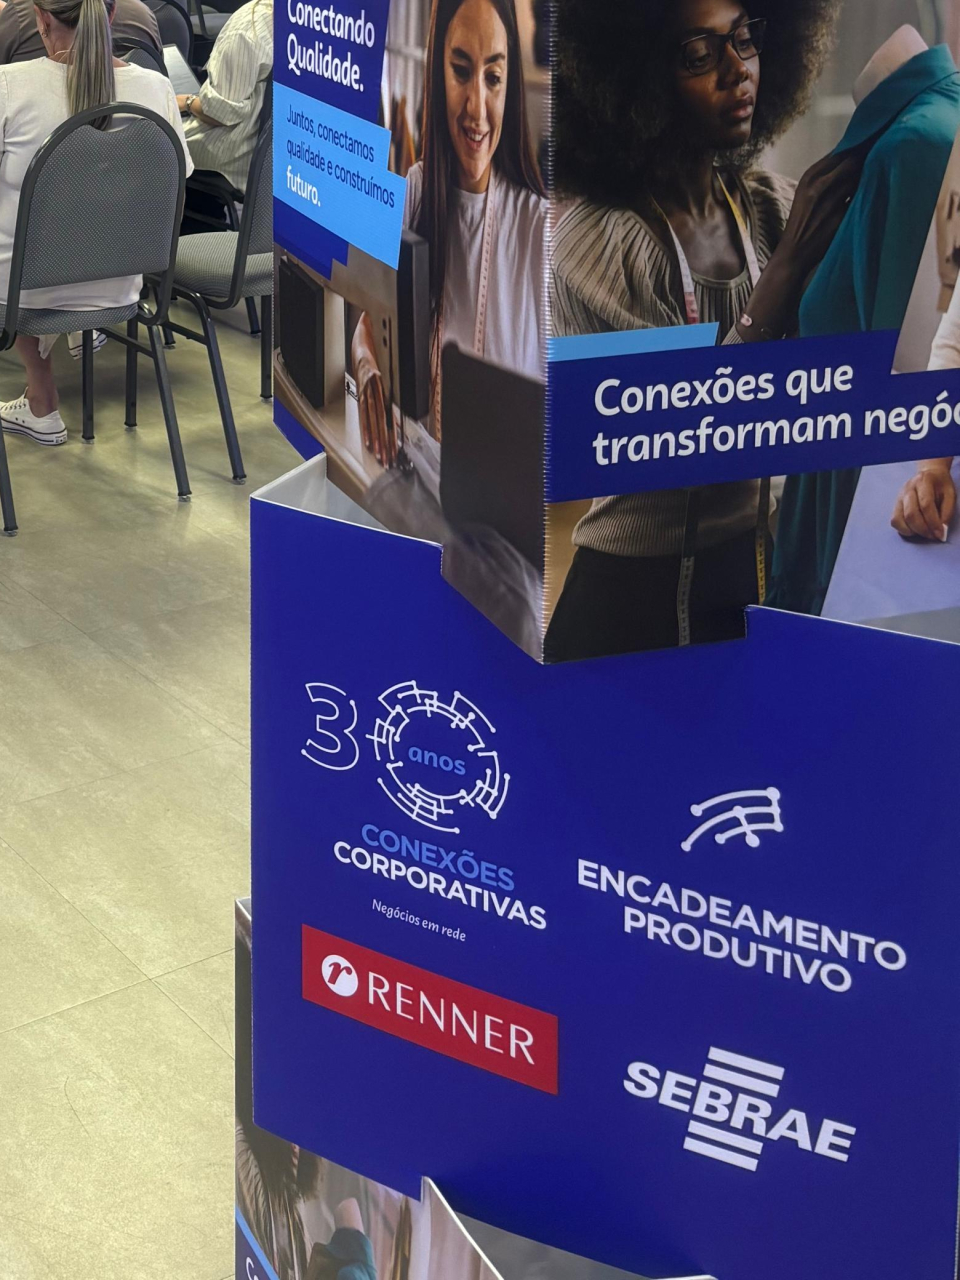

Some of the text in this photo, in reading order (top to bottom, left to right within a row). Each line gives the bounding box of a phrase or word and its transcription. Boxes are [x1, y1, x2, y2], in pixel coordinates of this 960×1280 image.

[287, 32, 364, 92] Qualidade.
[286, 104, 375, 163] Juntos, conectamos
[286, 138, 395, 209] qualidade e construímos
[286, 165, 321, 207] futuro.
[594, 364, 853, 417] Conexões que
[592, 409, 852, 466] transformam
[408, 745, 466, 776] anos
[333, 841, 547, 930] CORPORATIVAS
[361, 823, 515, 892] CONEXÕES
[372, 898, 467, 943] Negócios em rede
[577, 858, 907, 971] ENCADEAMENTO
[624, 906, 852, 993] PRODUTIVO
[367, 970, 535, 1066] RENNER
[623, 1061, 856, 1162] SEBRAE
